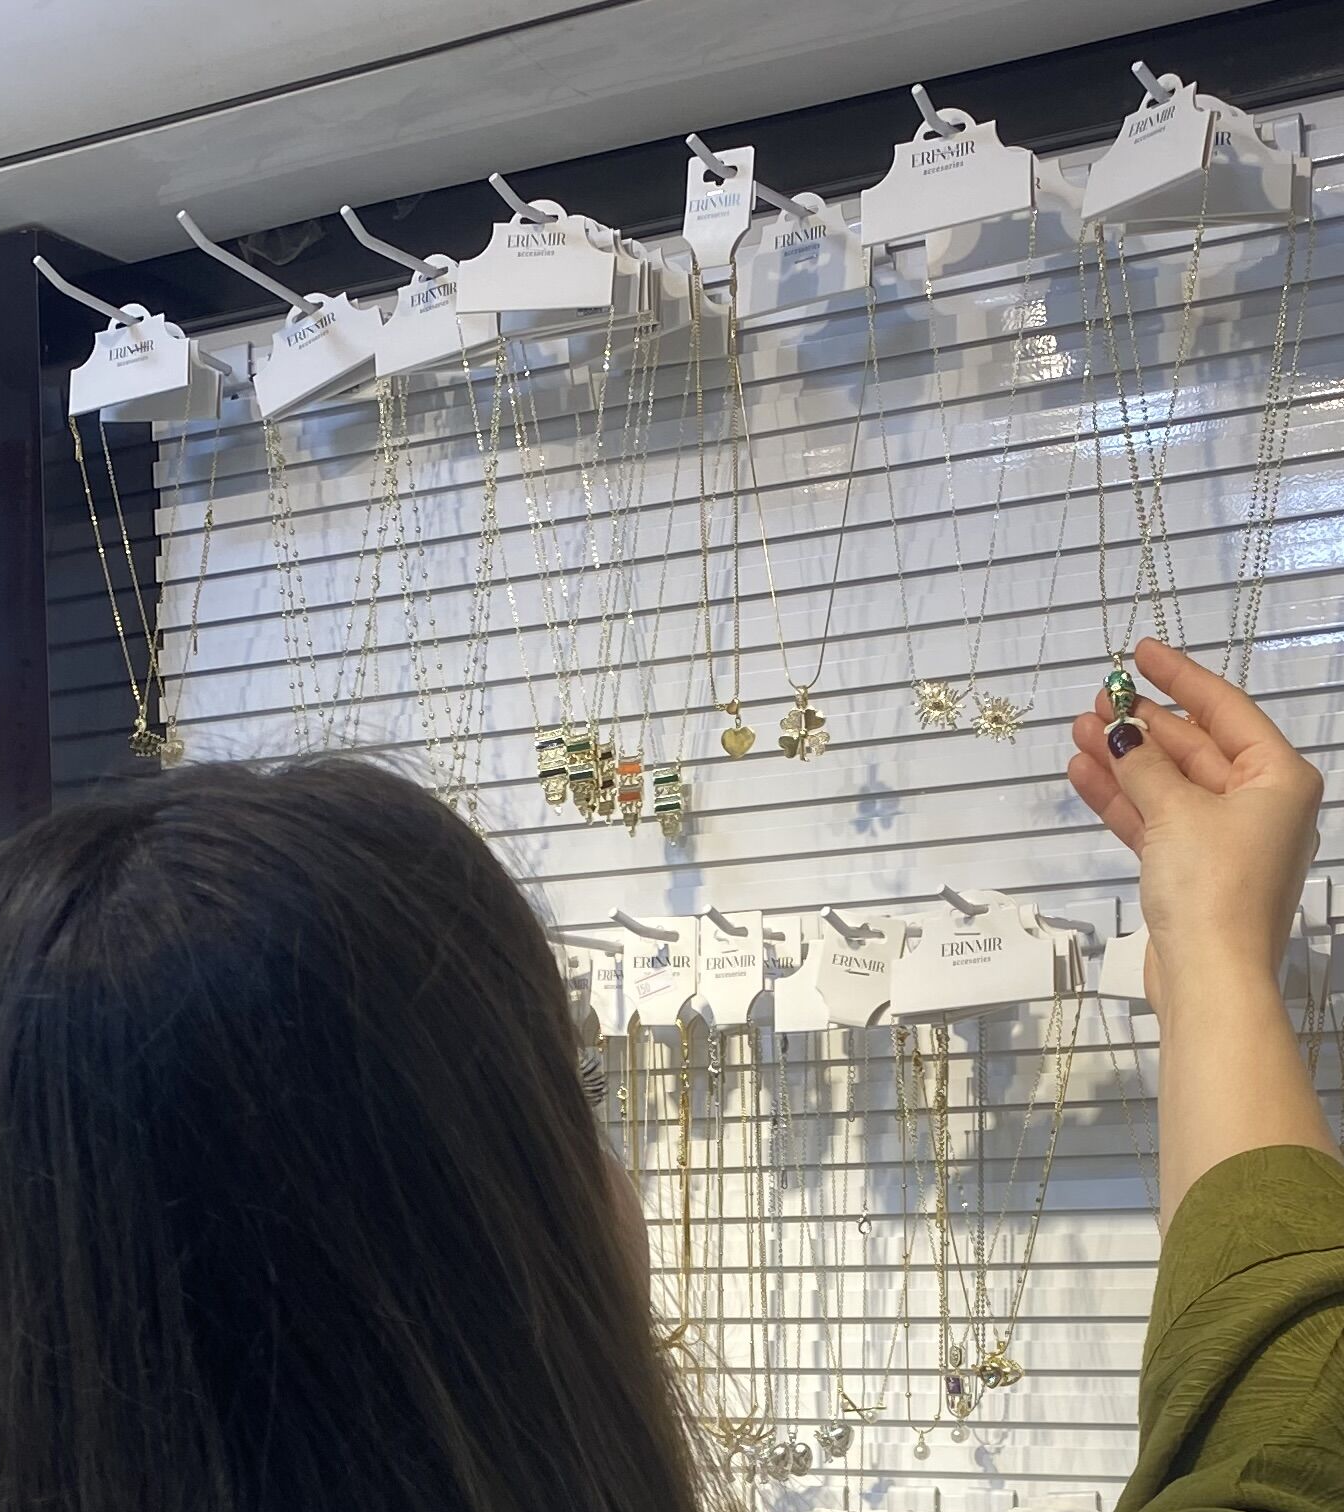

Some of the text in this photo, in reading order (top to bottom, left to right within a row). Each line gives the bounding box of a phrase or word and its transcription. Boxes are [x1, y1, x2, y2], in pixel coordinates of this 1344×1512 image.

[1128, 105, 1177, 139] ERINMIR
[911, 140, 976, 169] ERINMIR
[689, 192, 742, 213] ERINMIR
[507, 231, 567, 249] ERINMIR
[774, 224, 828, 250] ERINMIR
[941, 937, 1004, 958] ERINMIR
[634, 955, 691, 969] ERINMIR
[706, 954, 756, 970] ERINMIR
[832, 953, 885, 974] ERINMIR
